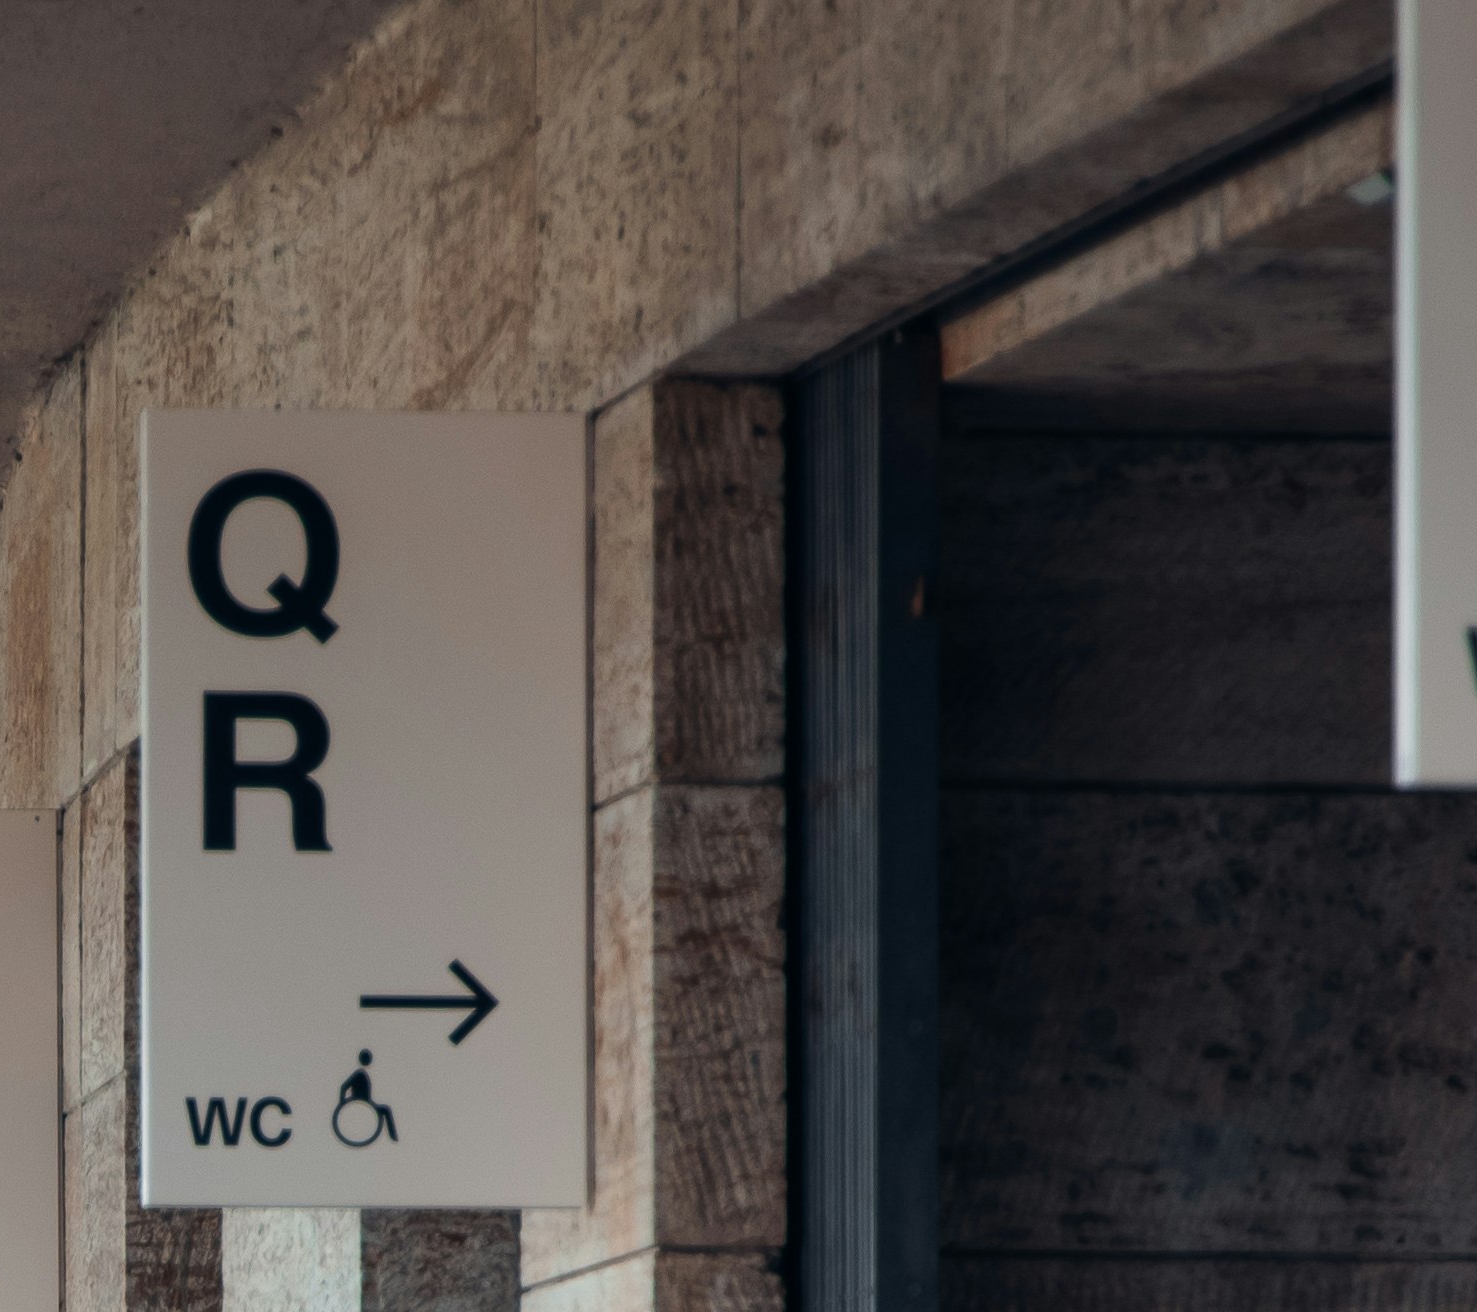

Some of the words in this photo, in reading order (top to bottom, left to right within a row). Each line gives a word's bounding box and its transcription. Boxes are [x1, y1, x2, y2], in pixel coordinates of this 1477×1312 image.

[187, 468, 341, 645] Q
[202, 690, 333, 852] R
[185, 1096, 292, 1148] WC
